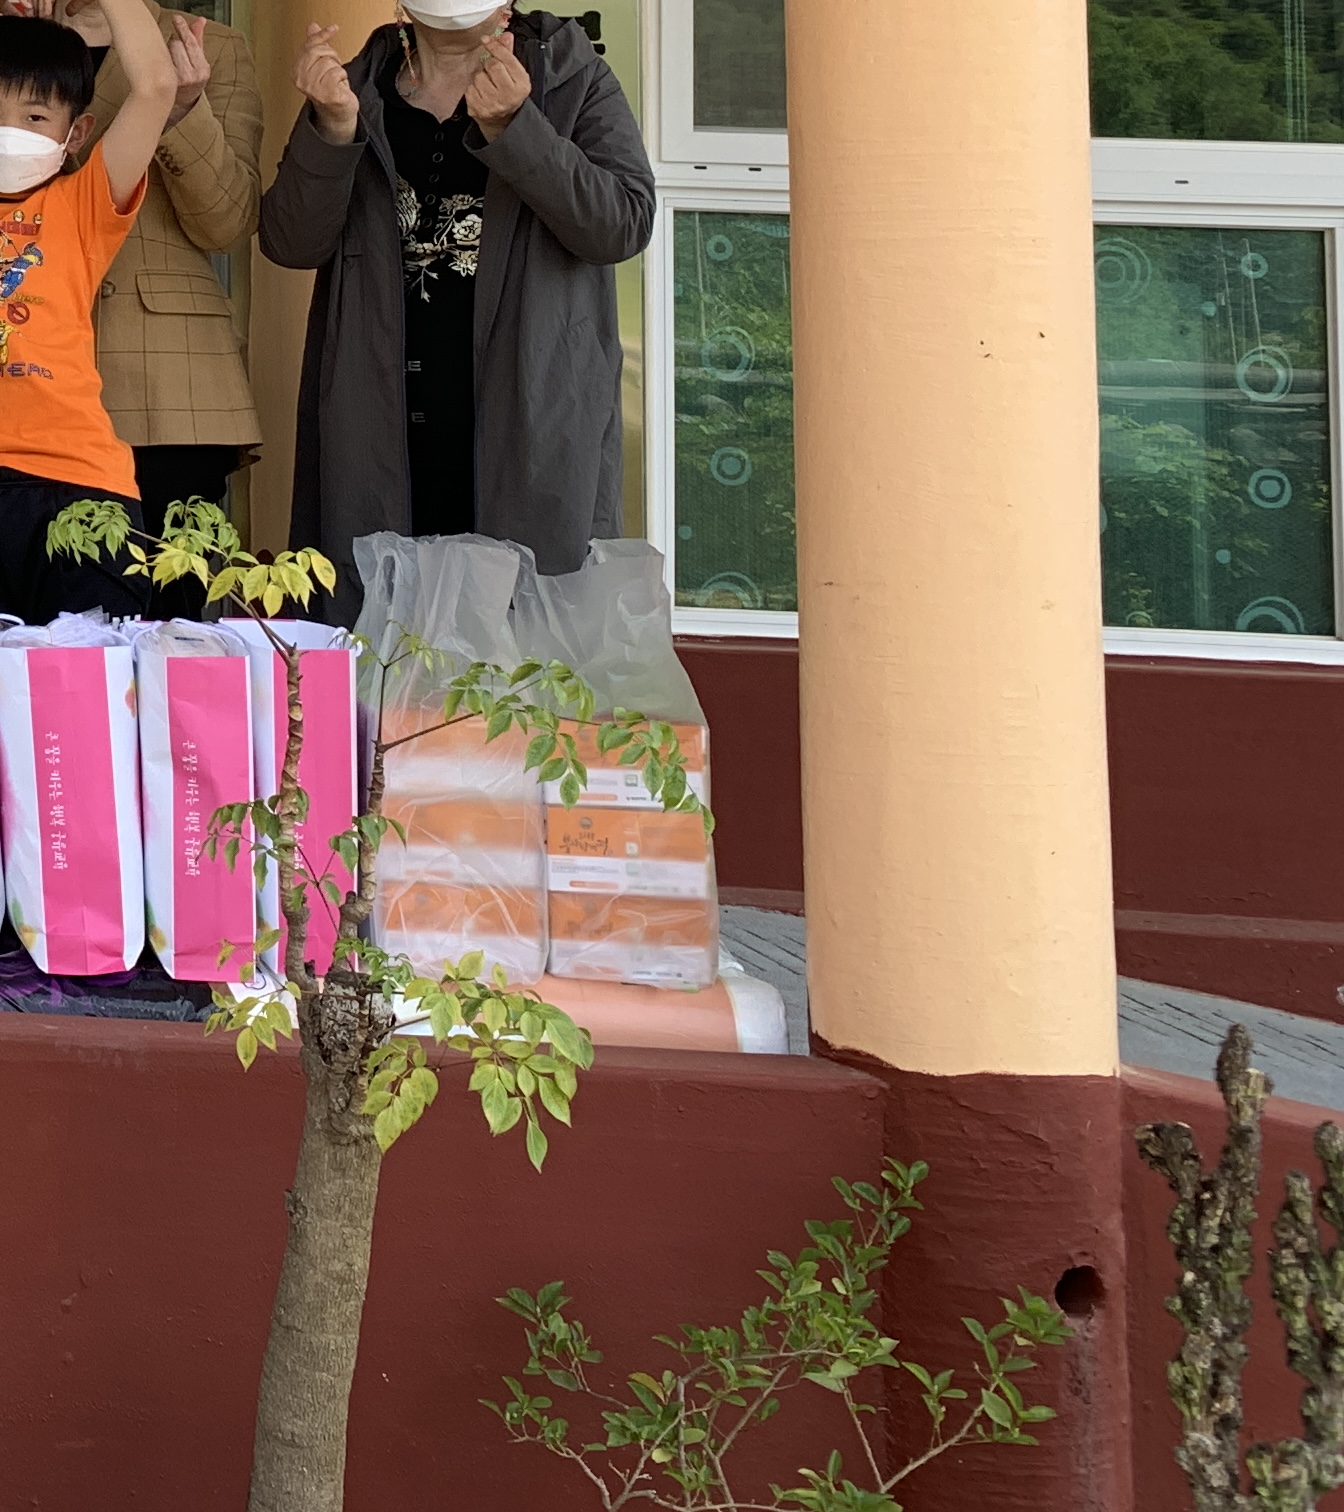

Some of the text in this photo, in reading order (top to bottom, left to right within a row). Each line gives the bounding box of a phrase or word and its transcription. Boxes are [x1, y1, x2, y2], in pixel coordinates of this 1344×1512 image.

[45, 731, 59, 742] 큰
[182, 739, 197, 750] 큰
[44, 745, 60, 766] 꿈을
[181, 754, 198, 773] 꿈을
[48, 770, 64, 801] 키우는
[184, 776, 200, 806] 키우는
[49, 804, 66, 827] 행복
[184, 811, 201, 833] 행복
